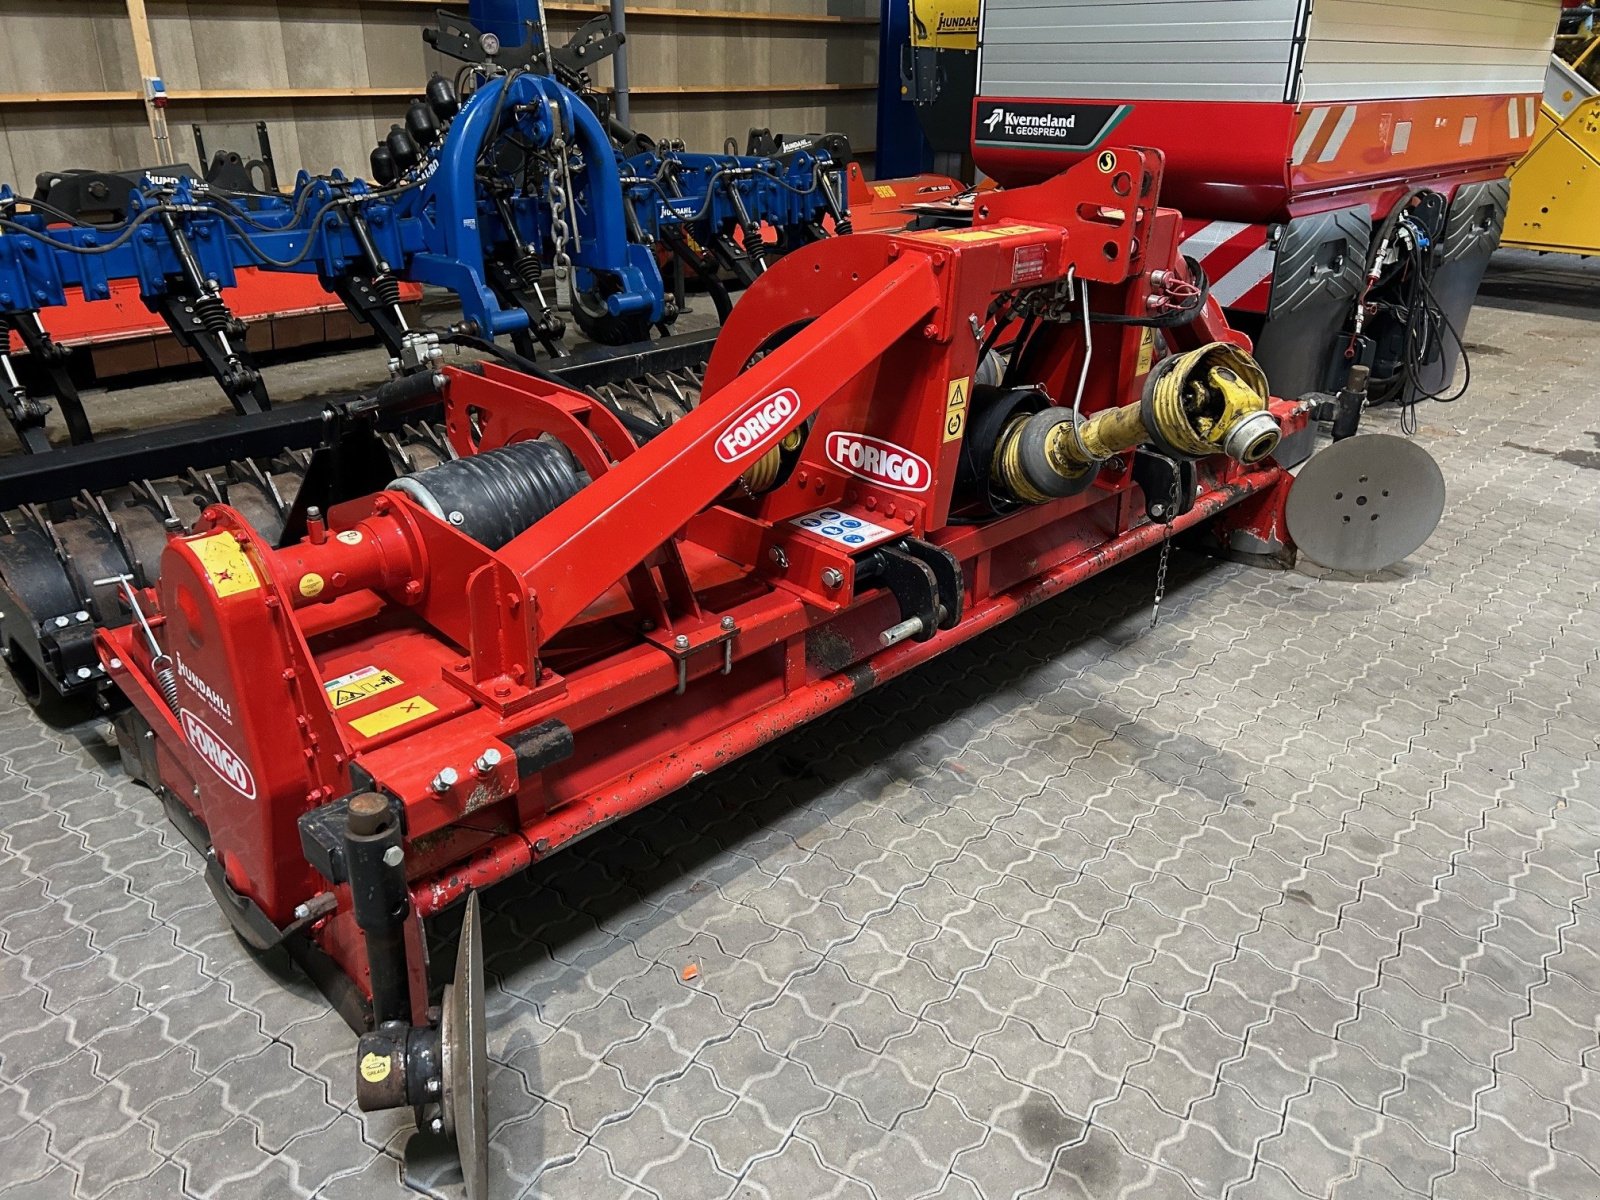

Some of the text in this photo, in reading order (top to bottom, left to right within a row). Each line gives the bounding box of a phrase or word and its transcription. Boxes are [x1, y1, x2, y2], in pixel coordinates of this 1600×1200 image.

[1004, 112, 1075, 128] Kverneland
[1004, 125, 1067, 137] TL GEOSPREAD
[721, 395, 792, 457] FORIGO
[836, 436, 920, 486] FORIGO
[186, 714, 247, 790] FORIGO
